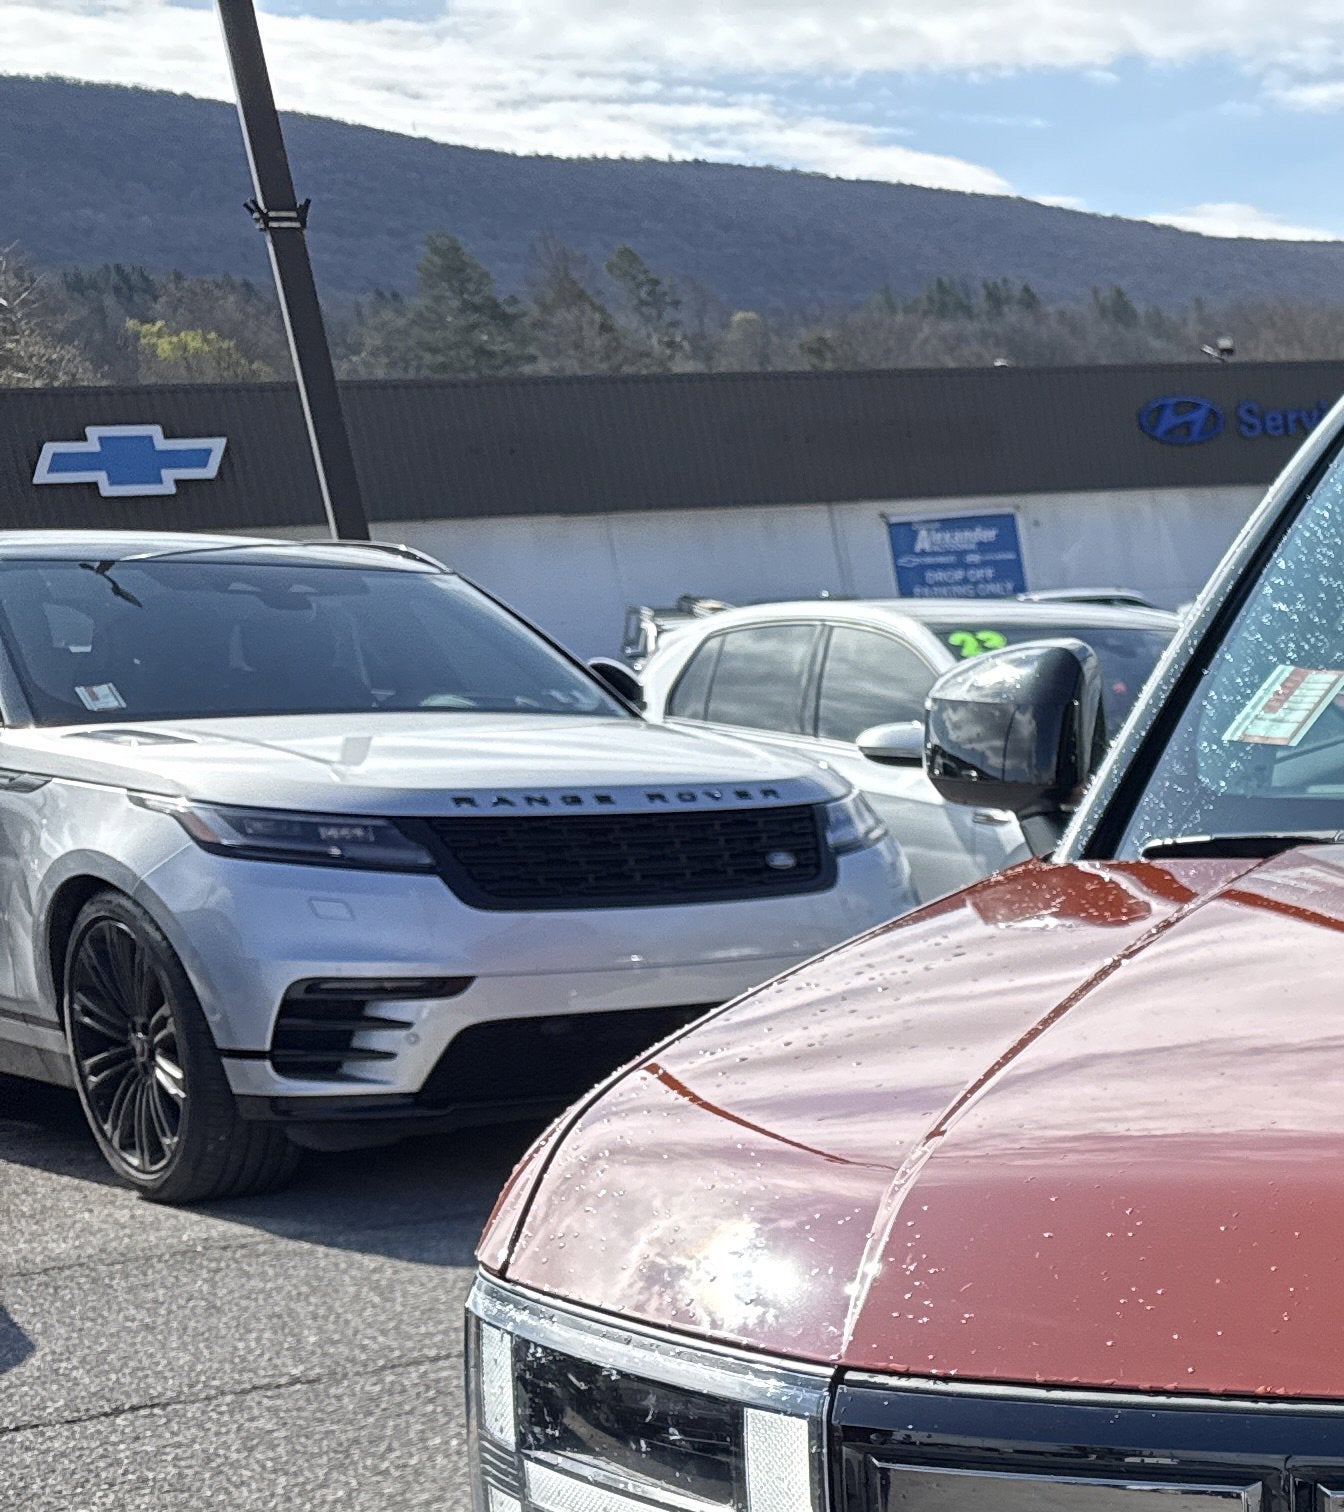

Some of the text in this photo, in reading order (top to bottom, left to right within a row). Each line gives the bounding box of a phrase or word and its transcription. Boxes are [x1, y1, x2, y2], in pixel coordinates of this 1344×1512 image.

[1238, 400, 1329, 437] Serv
[452, 788, 779, 807] RANGE ROVER
